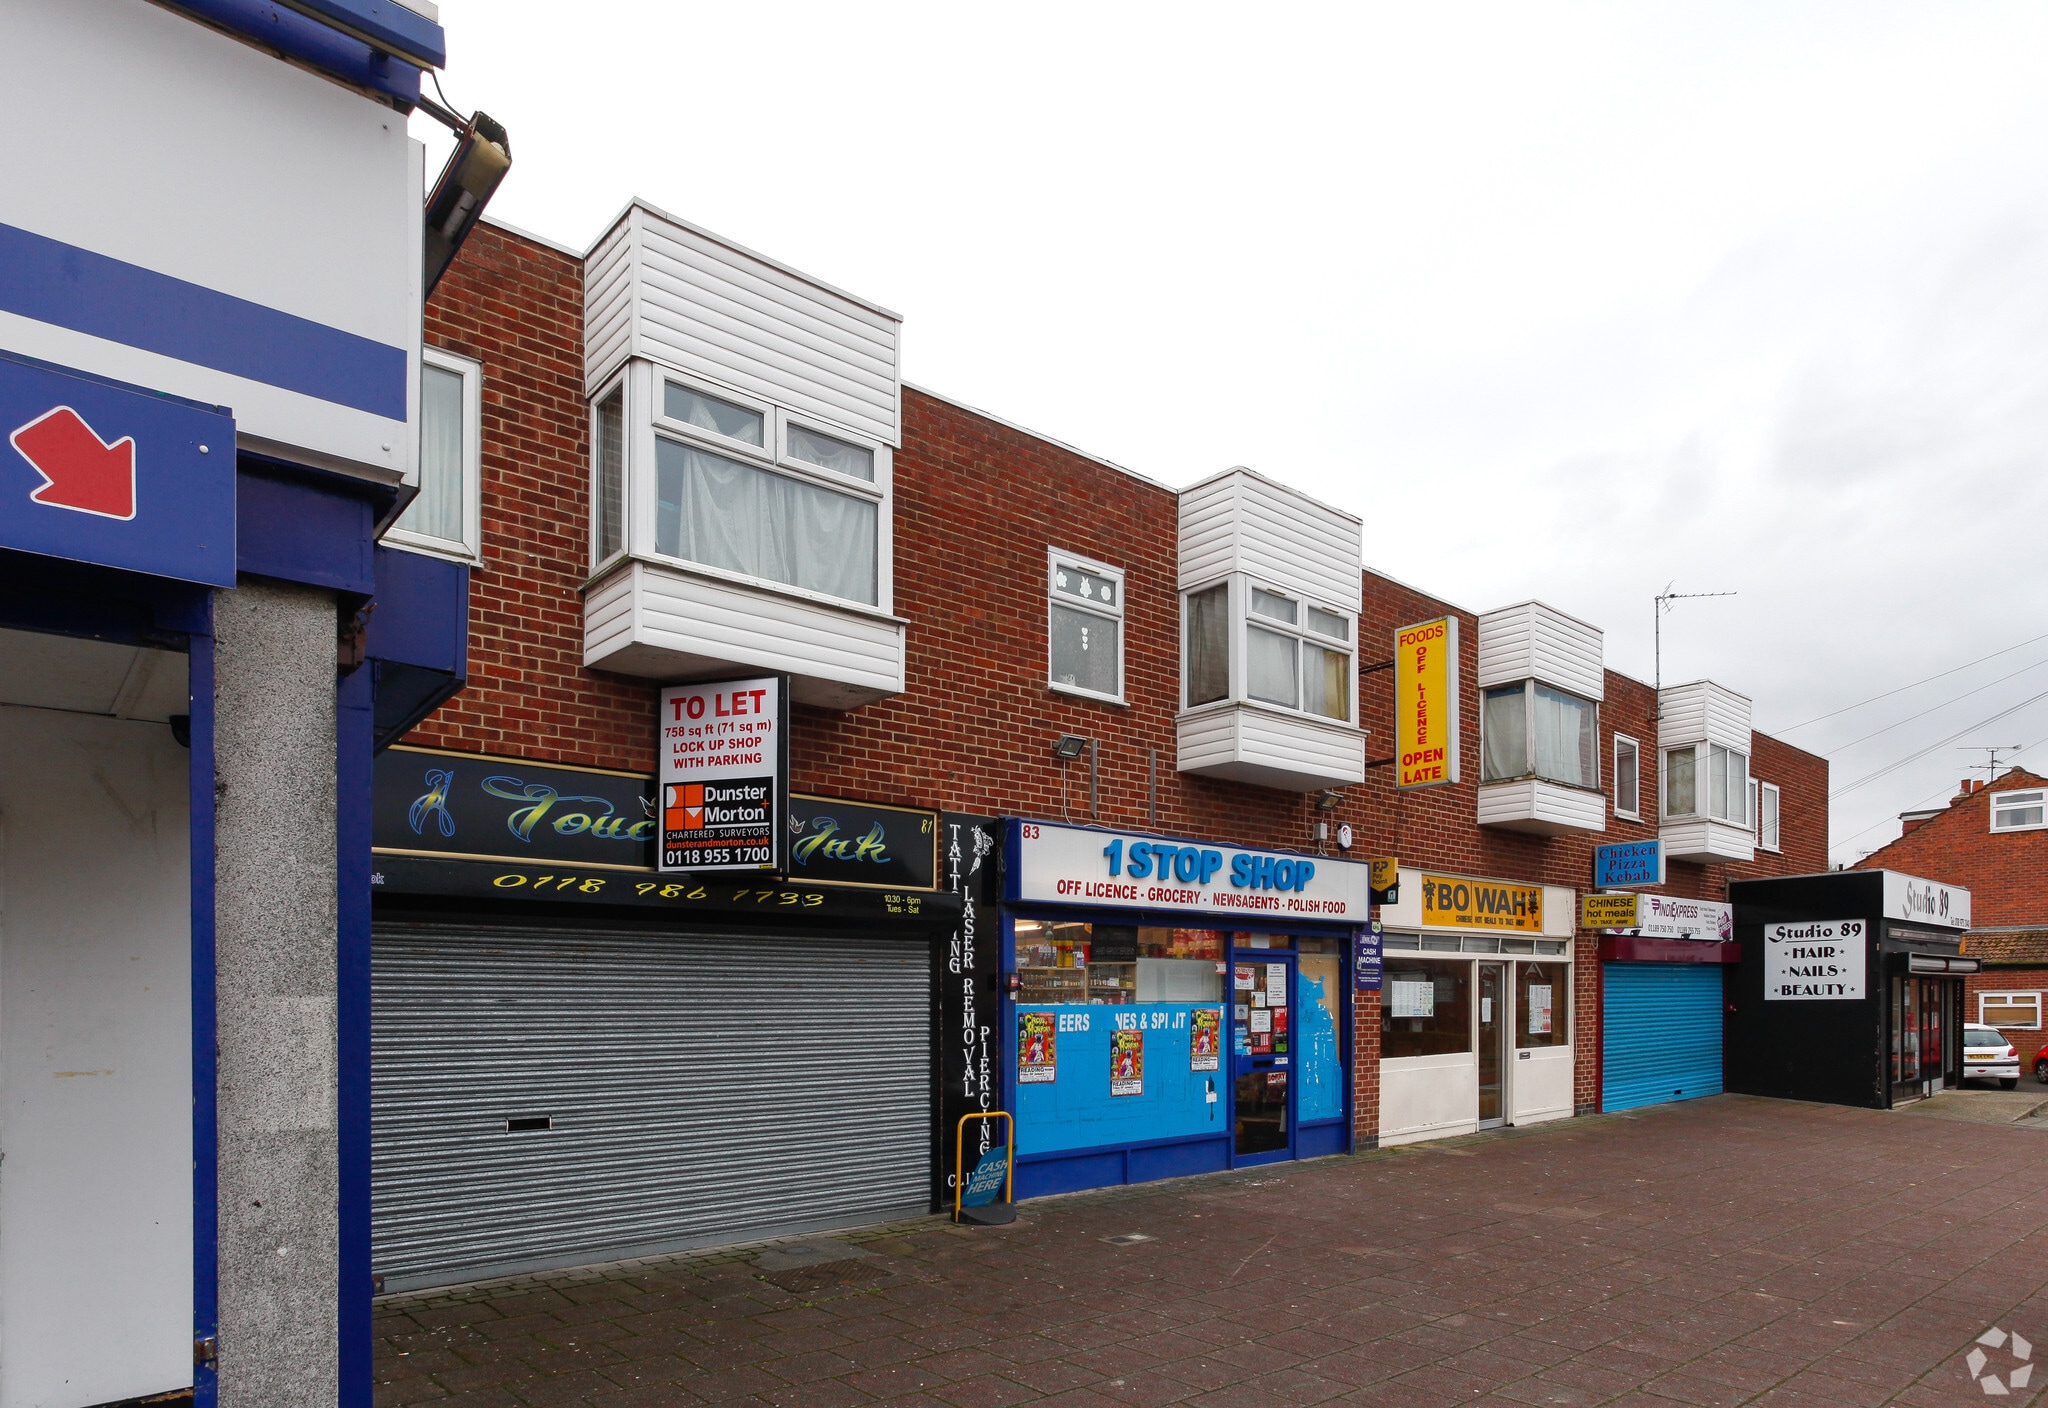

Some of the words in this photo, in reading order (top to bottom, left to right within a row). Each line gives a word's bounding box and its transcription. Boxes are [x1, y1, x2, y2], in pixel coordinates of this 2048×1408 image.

[1400, 625, 1444, 647] FOODS
[1416, 646, 1427, 674] OFF
[670, 695, 706, 721] TO
[715, 689, 766, 717] LET
[1417, 683, 1427, 745] LICENCE
[665, 726, 685, 738] 758
[688, 726, 702, 738] sq
[705, 724, 714, 734] ft
[717, 722, 735, 736] (71
[739, 723, 753, 734] sq
[757, 719, 772, 732] m)
[673, 741, 705, 754] LOCK
[708, 739, 724, 751] UP
[728, 736, 762, 750] SHOP
[674, 756, 704, 769] WITH
[708, 752, 762, 767] PARKING
[1402, 748, 1444, 766] OPEN
[1404, 766, 1442, 784] LATE
[704, 786, 766, 802] Dunster
[408, 768, 456, 836] A
[481, 776, 657, 842] Touc
[704, 806, 764, 822] Morton
[666, 829, 714, 840] CHARTERED
[720, 826, 770, 838] SURVEYORS
[920, 819, 932, 834] 81
[1022, 825, 1040, 840] 83
[666, 836, 769, 850] dunsterandmorton.co.uk
[792, 816, 891, 866] Ink
[666, 850, 700, 865] 0118
[704, 848, 730, 864] 955
[734, 846, 770, 862] 1700
[1600, 846, 1656, 860] Chicken
[1128, 841, 1223, 884] STOP
[1230, 853, 1315, 892] SHOP
[1610, 859, 1646, 870] Pizza
[1606, 870, 1650, 883] Kebab
[493, 874, 606, 893] 0118
[635, 882, 707, 900] 986
[732, 889, 824, 907] 1733
[949, 824, 962, 974] TATTING
[1057, 879, 1082, 896] OFF
[1086, 882, 1138, 900] LICENCE
[1148, 887, 1201, 904] GROCERY
[1213, 892, 1280, 910] NEWSAGENTS
[1288, 898, 1320, 912] POLISH
[1322, 902, 1346, 914] FOOD
[884, 894, 900, 904] 10.30
[907, 896, 921, 906] 6pm
[1438, 883, 1470, 912] BO
[1474, 886, 1526, 916] WAH
[1588, 898, 1634, 908] CHINESE
[1902, 881, 1936, 919] Studio
[1939, 888, 1949, 918] 89
[886, 904, 902, 914] Tues
[908, 905, 919, 914] Sat
[1586, 909, 1602, 918] hot
[1605, 908, 1634, 917] meals
[962, 886, 976, 970] LASER
[1768, 923, 1832, 943] Studio
[1841, 922, 1862, 938] 89
[1358, 956, 1380, 964] MACHINE
[1792, 946, 1836, 959] HAIR
[1790, 964, 1838, 977] NAILS
[1781, 984, 1846, 996] BEAUTY
[1059, 1014, 1090, 1032] EERS
[1140, 1012, 1148, 1030] &
[1152, 1012, 1186, 1030] SPIIT
[962, 978, 976, 1098] REMOVAL
[1268, 1073, 1286, 1081] SORRY
[977, 1159, 1008, 1175] CASH
[973, 1170, 1005, 1183] MACHINE
[966, 1178, 1001, 1195] HERE
